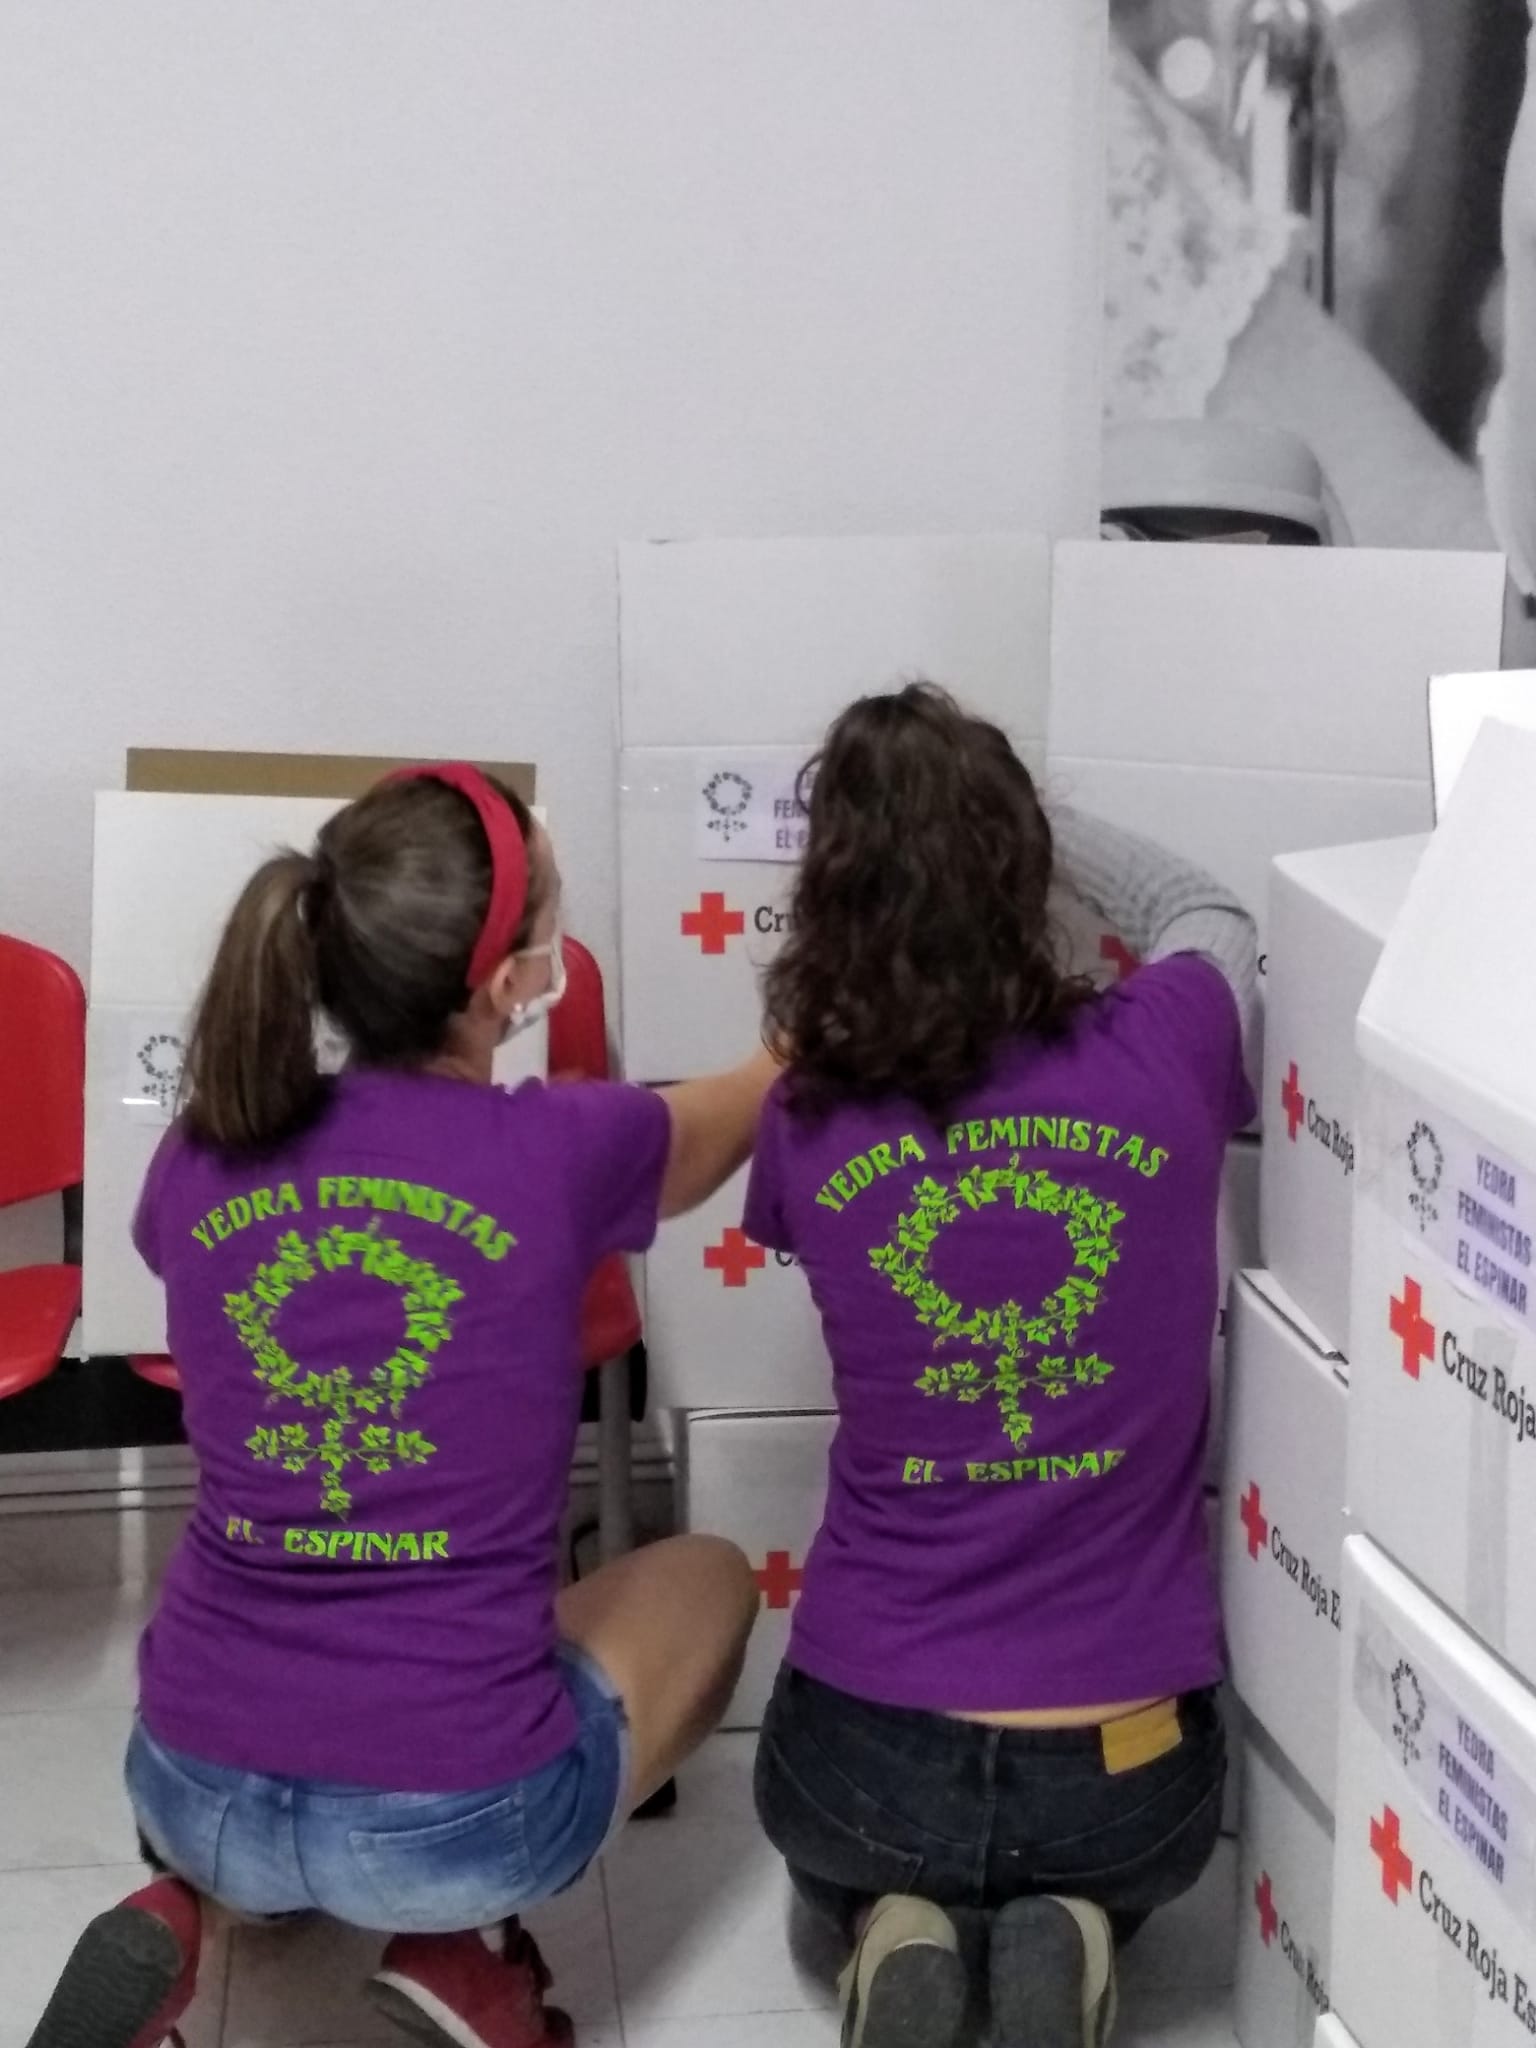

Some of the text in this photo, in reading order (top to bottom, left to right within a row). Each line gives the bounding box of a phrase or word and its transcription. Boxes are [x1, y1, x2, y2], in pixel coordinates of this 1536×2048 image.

[815, 1116, 1169, 1213] YEDRA FEMINISTAS
[1477, 1154, 1516, 1208] YEDRA
[191, 1176, 518, 1261] YEDRA FEMINISTAS
[1458, 1190, 1532, 1267] FEMINISTAS
[1457, 1239, 1528, 1315] EL ESPINAR
[1442, 1331, 1536, 1442] Cruz Roja
[284, 1528, 450, 1561] ESPINAR
[1272, 1526, 1299, 1582] Cruz
[1301, 1557, 1328, 1616] Roja
[1438, 1741, 1508, 1842] FEMINISTAS
[1458, 1716, 1494, 1780] YEDRA
[1438, 1787, 1504, 1883] EL ESPINAR
[1419, 1870, 1462, 1948] Cruz
[1466, 1920, 1508, 2003] Roja
